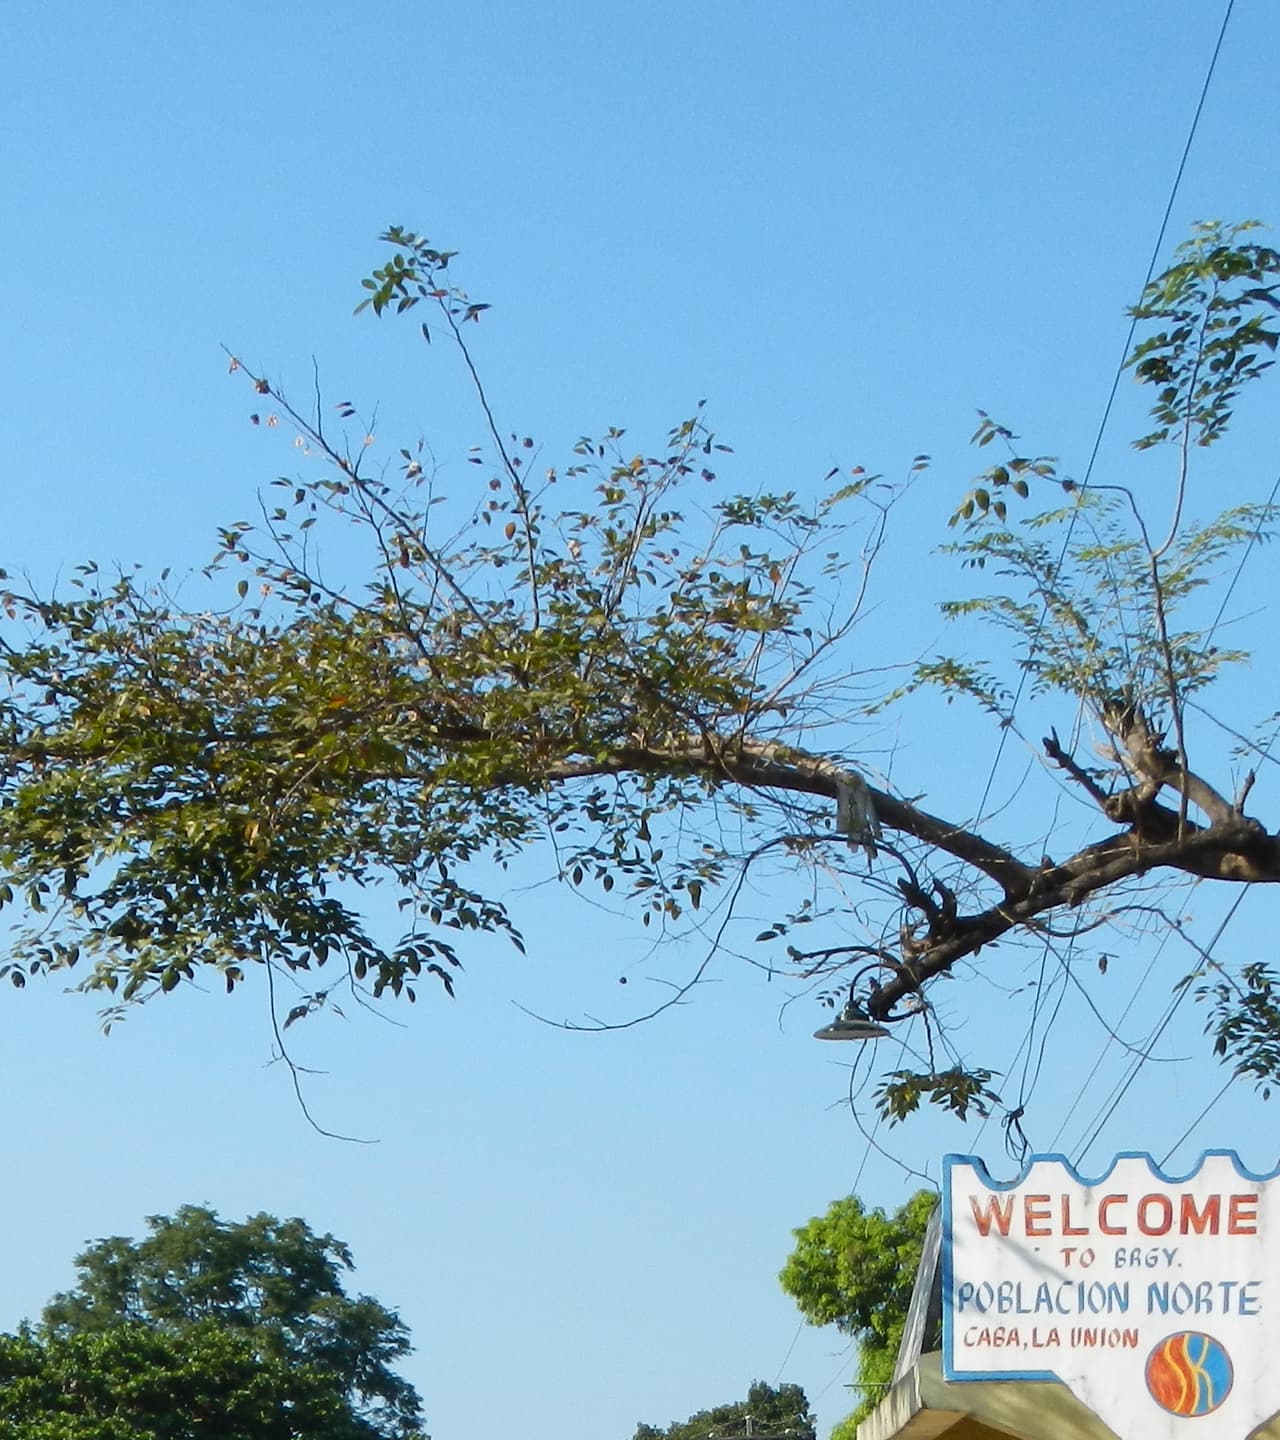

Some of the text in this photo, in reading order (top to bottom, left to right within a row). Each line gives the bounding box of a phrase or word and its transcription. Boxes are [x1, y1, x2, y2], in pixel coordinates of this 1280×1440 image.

[969, 1193, 1260, 1237] WELCOME
[1060, 1247, 1183, 1269] TO BRGY.
[958, 1280, 1263, 1316] POBLACION NORTE
[1070, 1327, 1139, 1349] UNION
